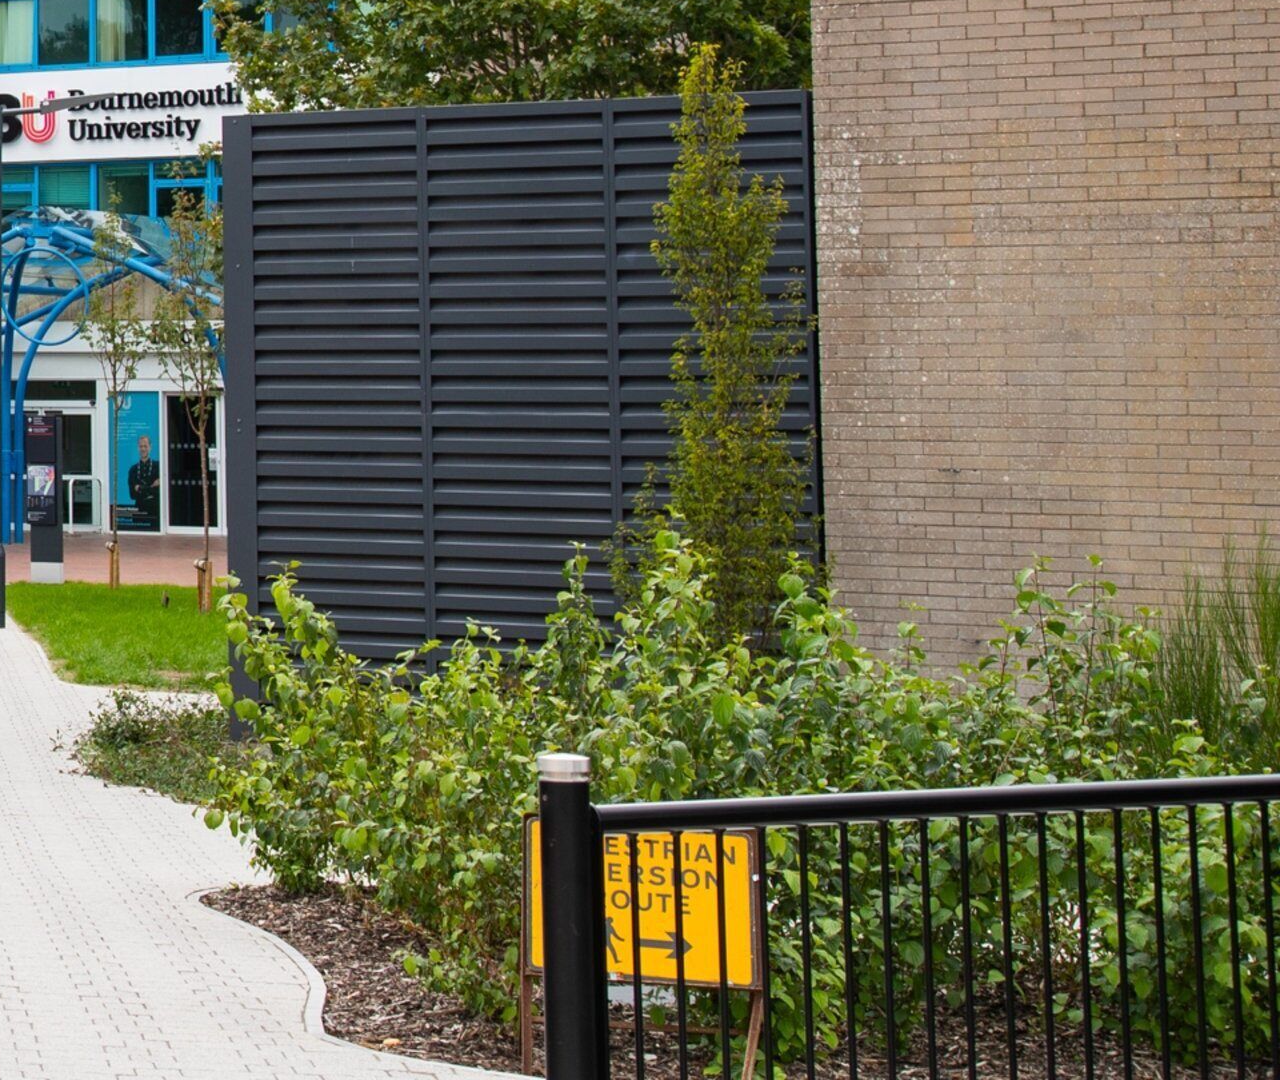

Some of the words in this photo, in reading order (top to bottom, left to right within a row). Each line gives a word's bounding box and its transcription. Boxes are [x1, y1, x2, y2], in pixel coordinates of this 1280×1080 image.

[68, 82, 243, 112] Bournemouth
[68, 115, 201, 141] University
[605, 836, 736, 865] ESTRIAN
[608, 863, 719, 889] ERSION
[608, 889, 691, 915] OUTE
